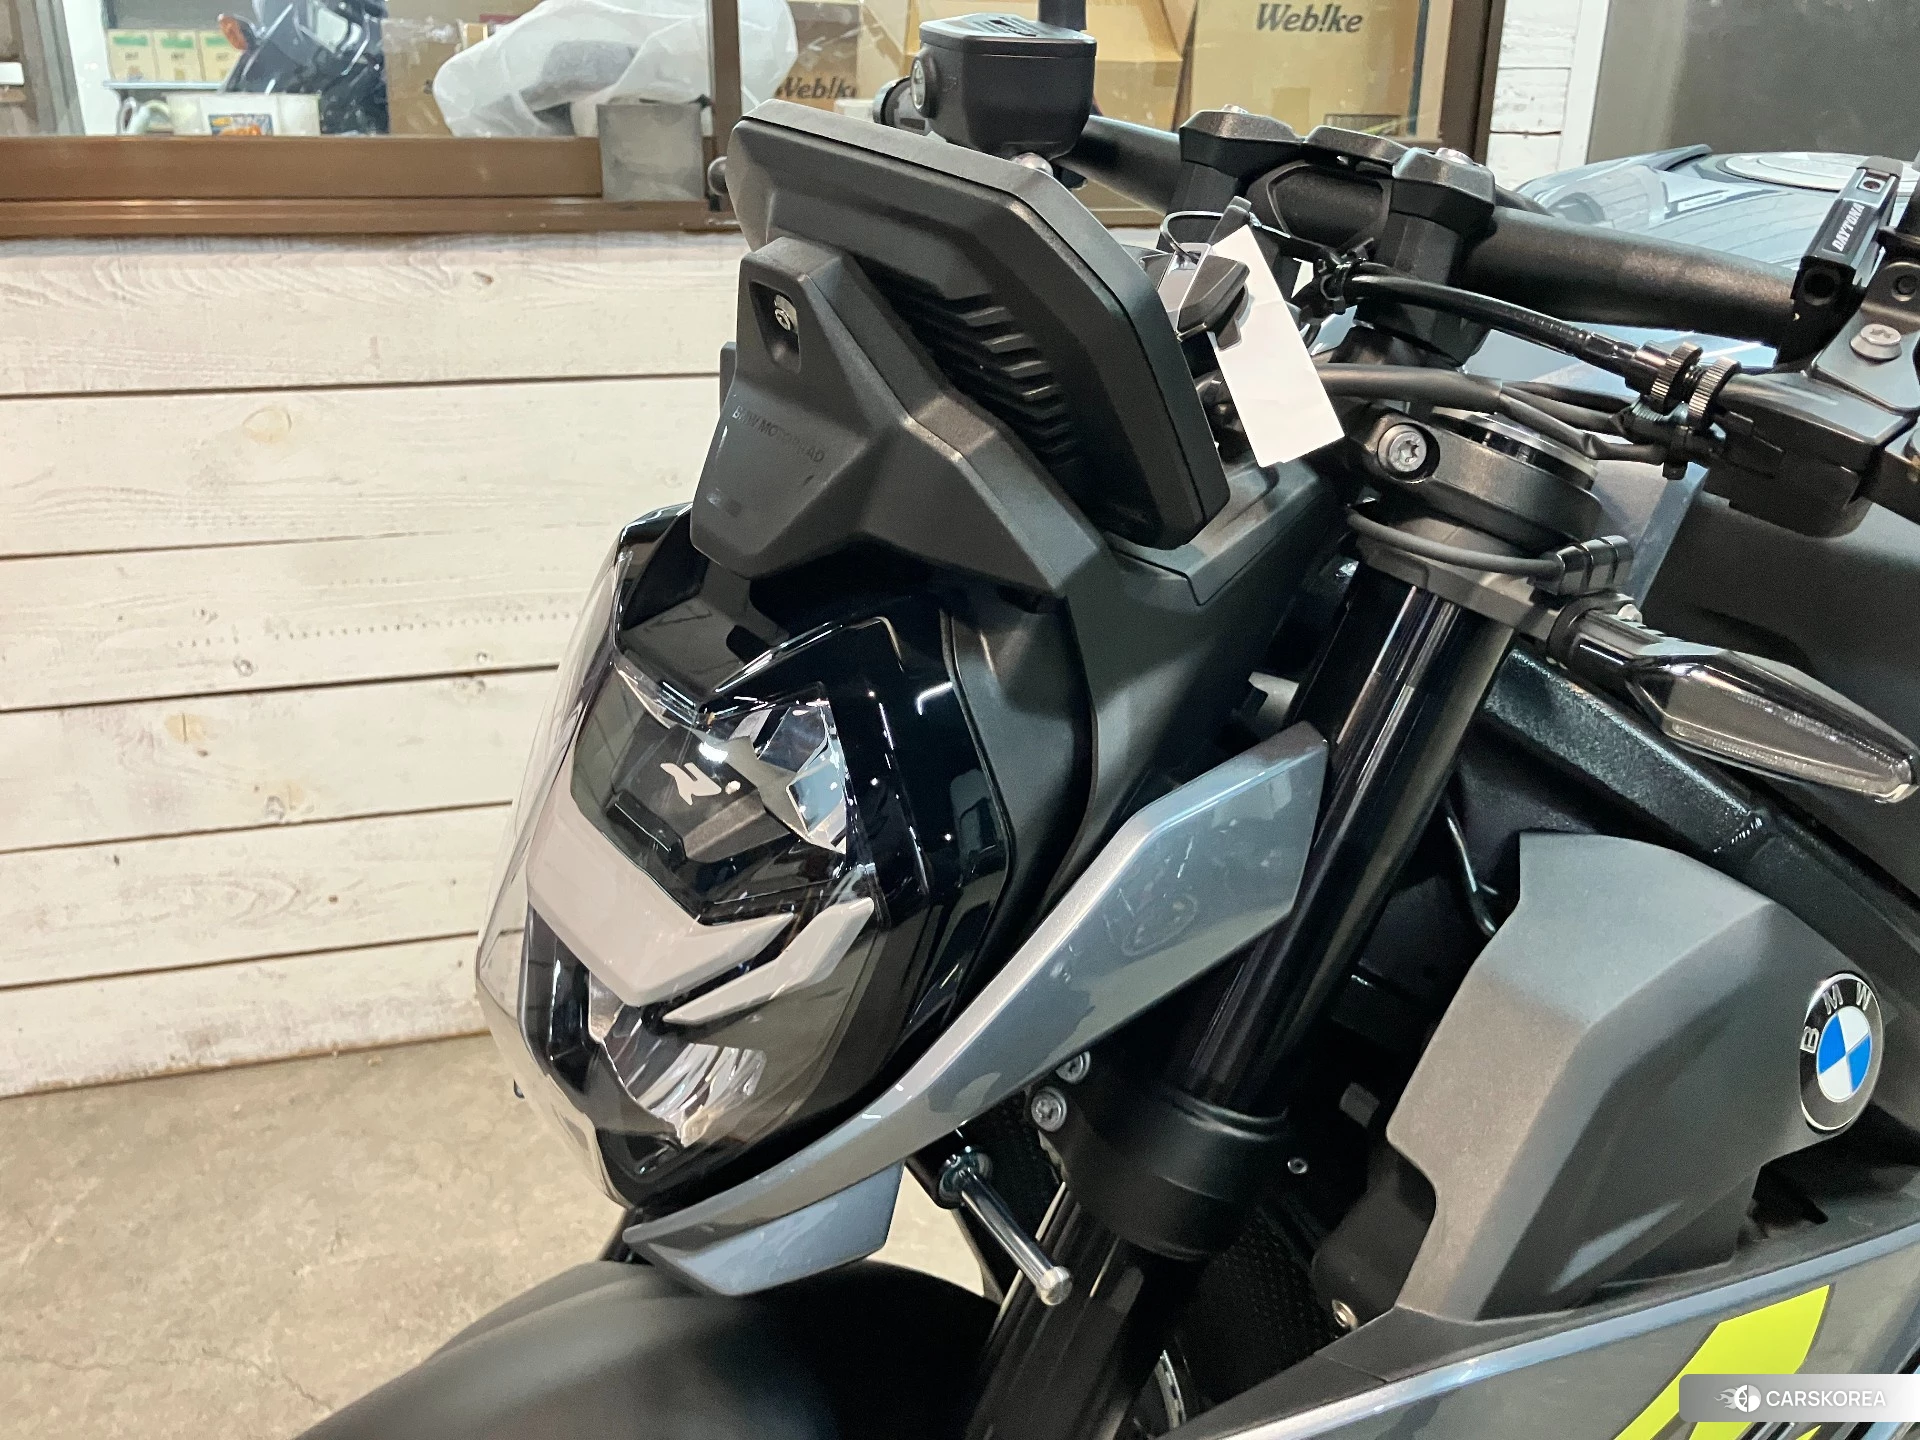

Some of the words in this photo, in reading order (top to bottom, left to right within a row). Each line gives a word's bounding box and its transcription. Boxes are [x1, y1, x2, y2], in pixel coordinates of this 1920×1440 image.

[1256, 3, 1363, 33] Web!ke
[1831, 202, 1866, 252] DAYTONA
[1800, 982, 1872, 1053] BMW
